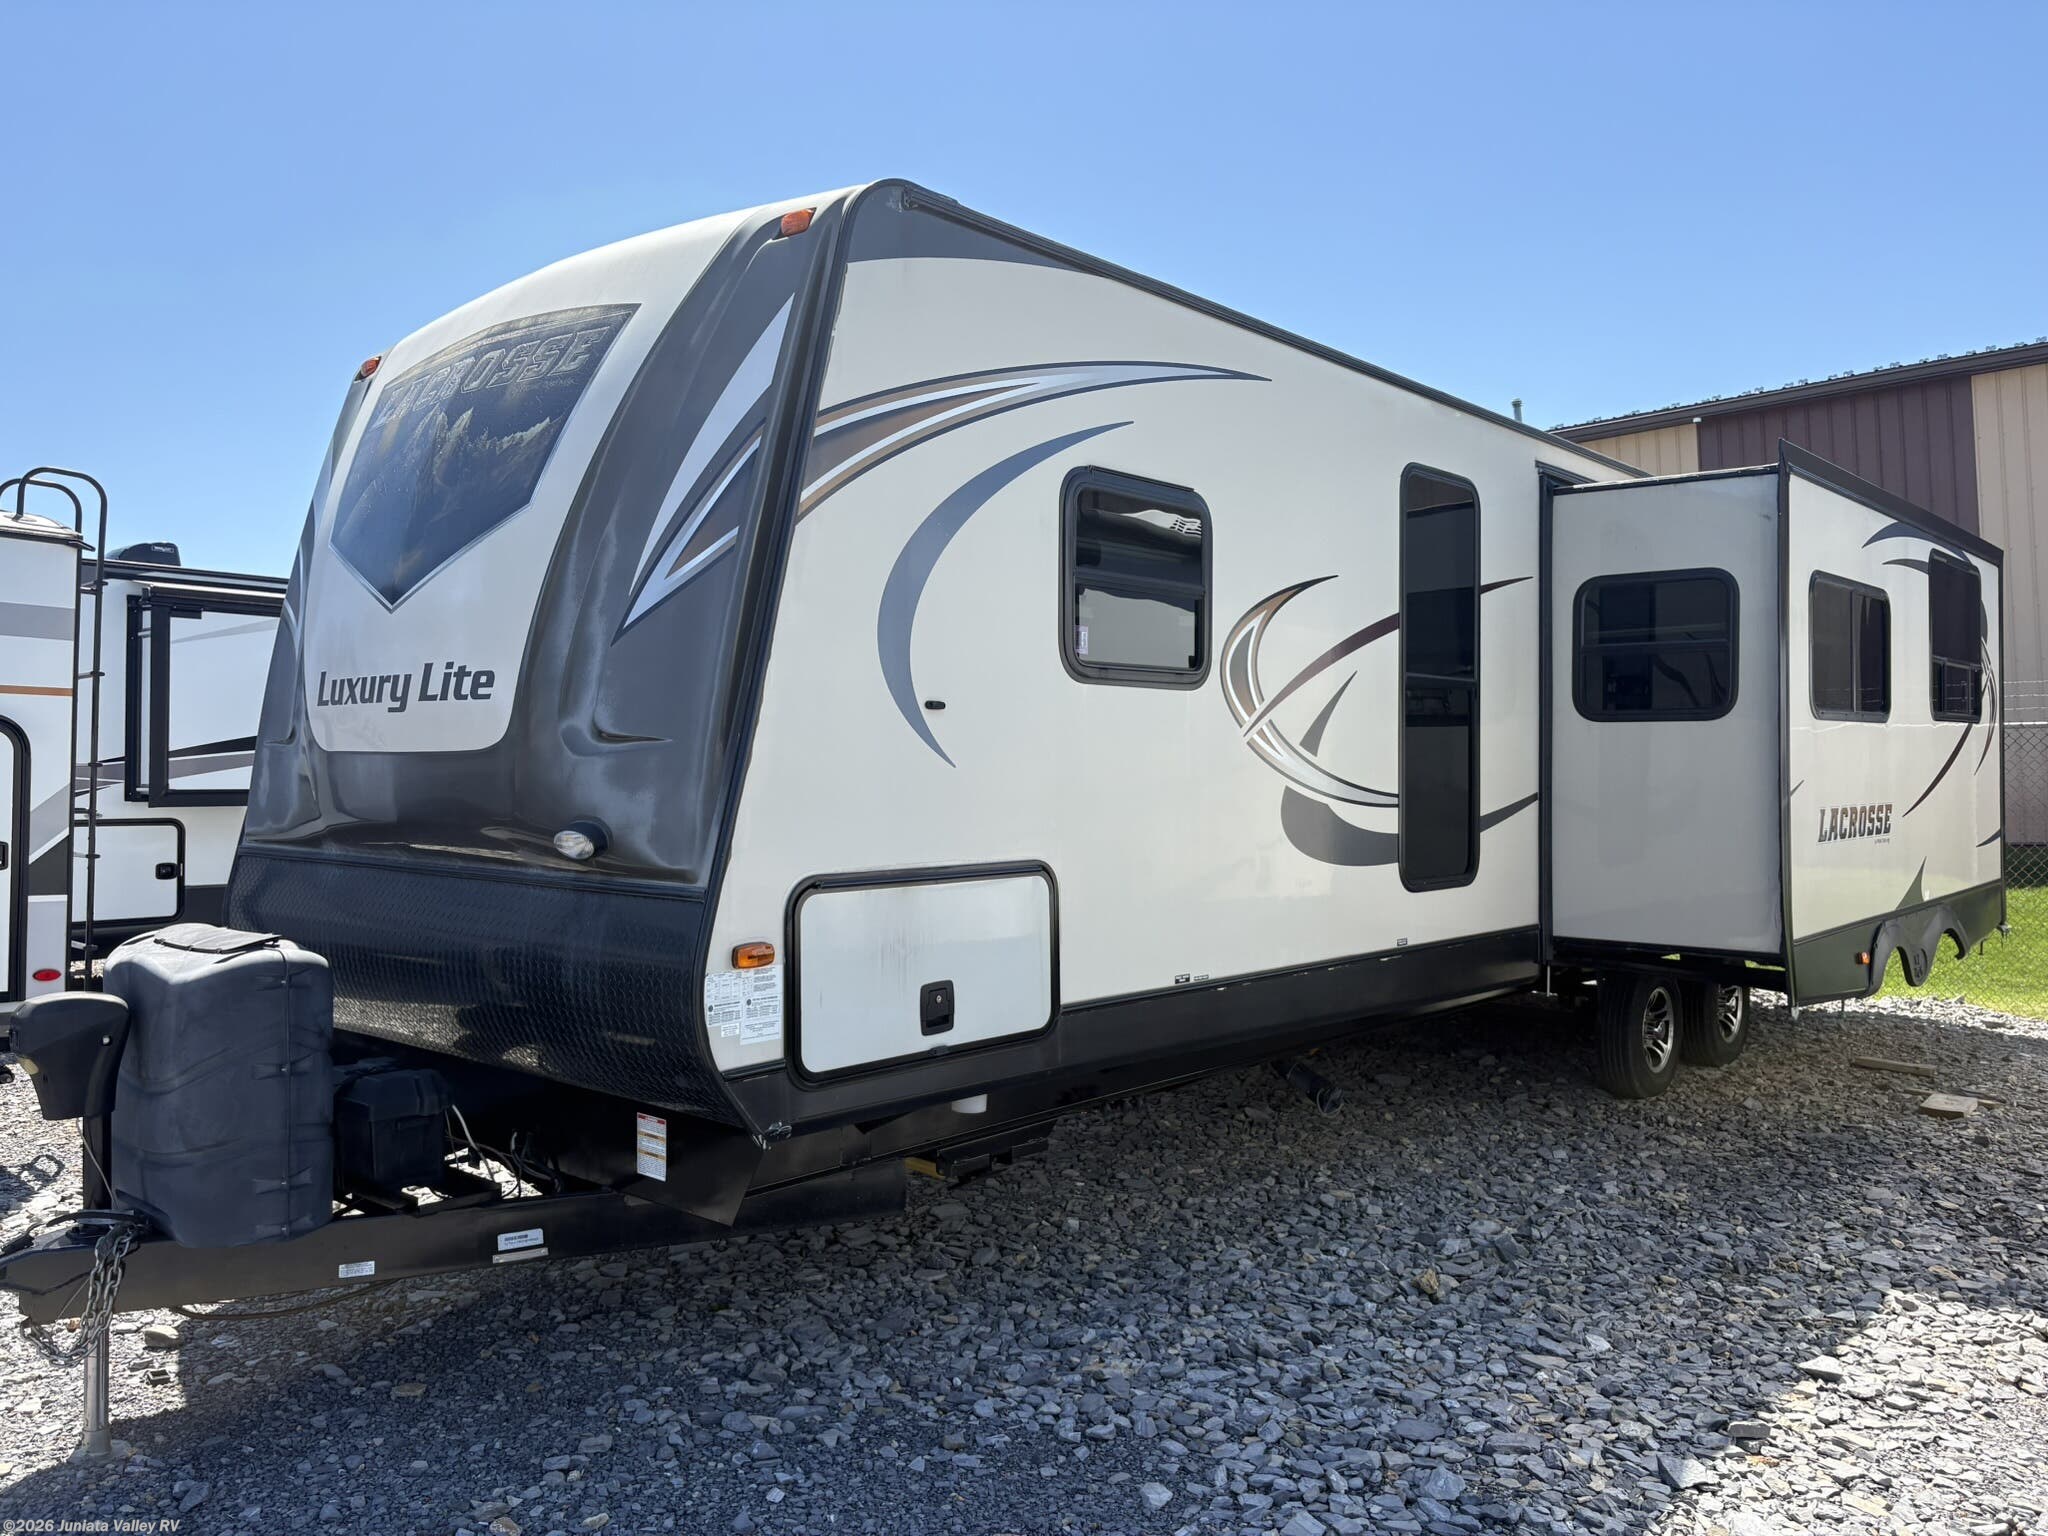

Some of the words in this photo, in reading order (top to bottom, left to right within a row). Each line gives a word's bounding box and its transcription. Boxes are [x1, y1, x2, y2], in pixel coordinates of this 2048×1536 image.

[317, 671, 412, 713] Luxury
[418, 661, 496, 702] Lite
[1817, 803, 1893, 843] LACROSSE
